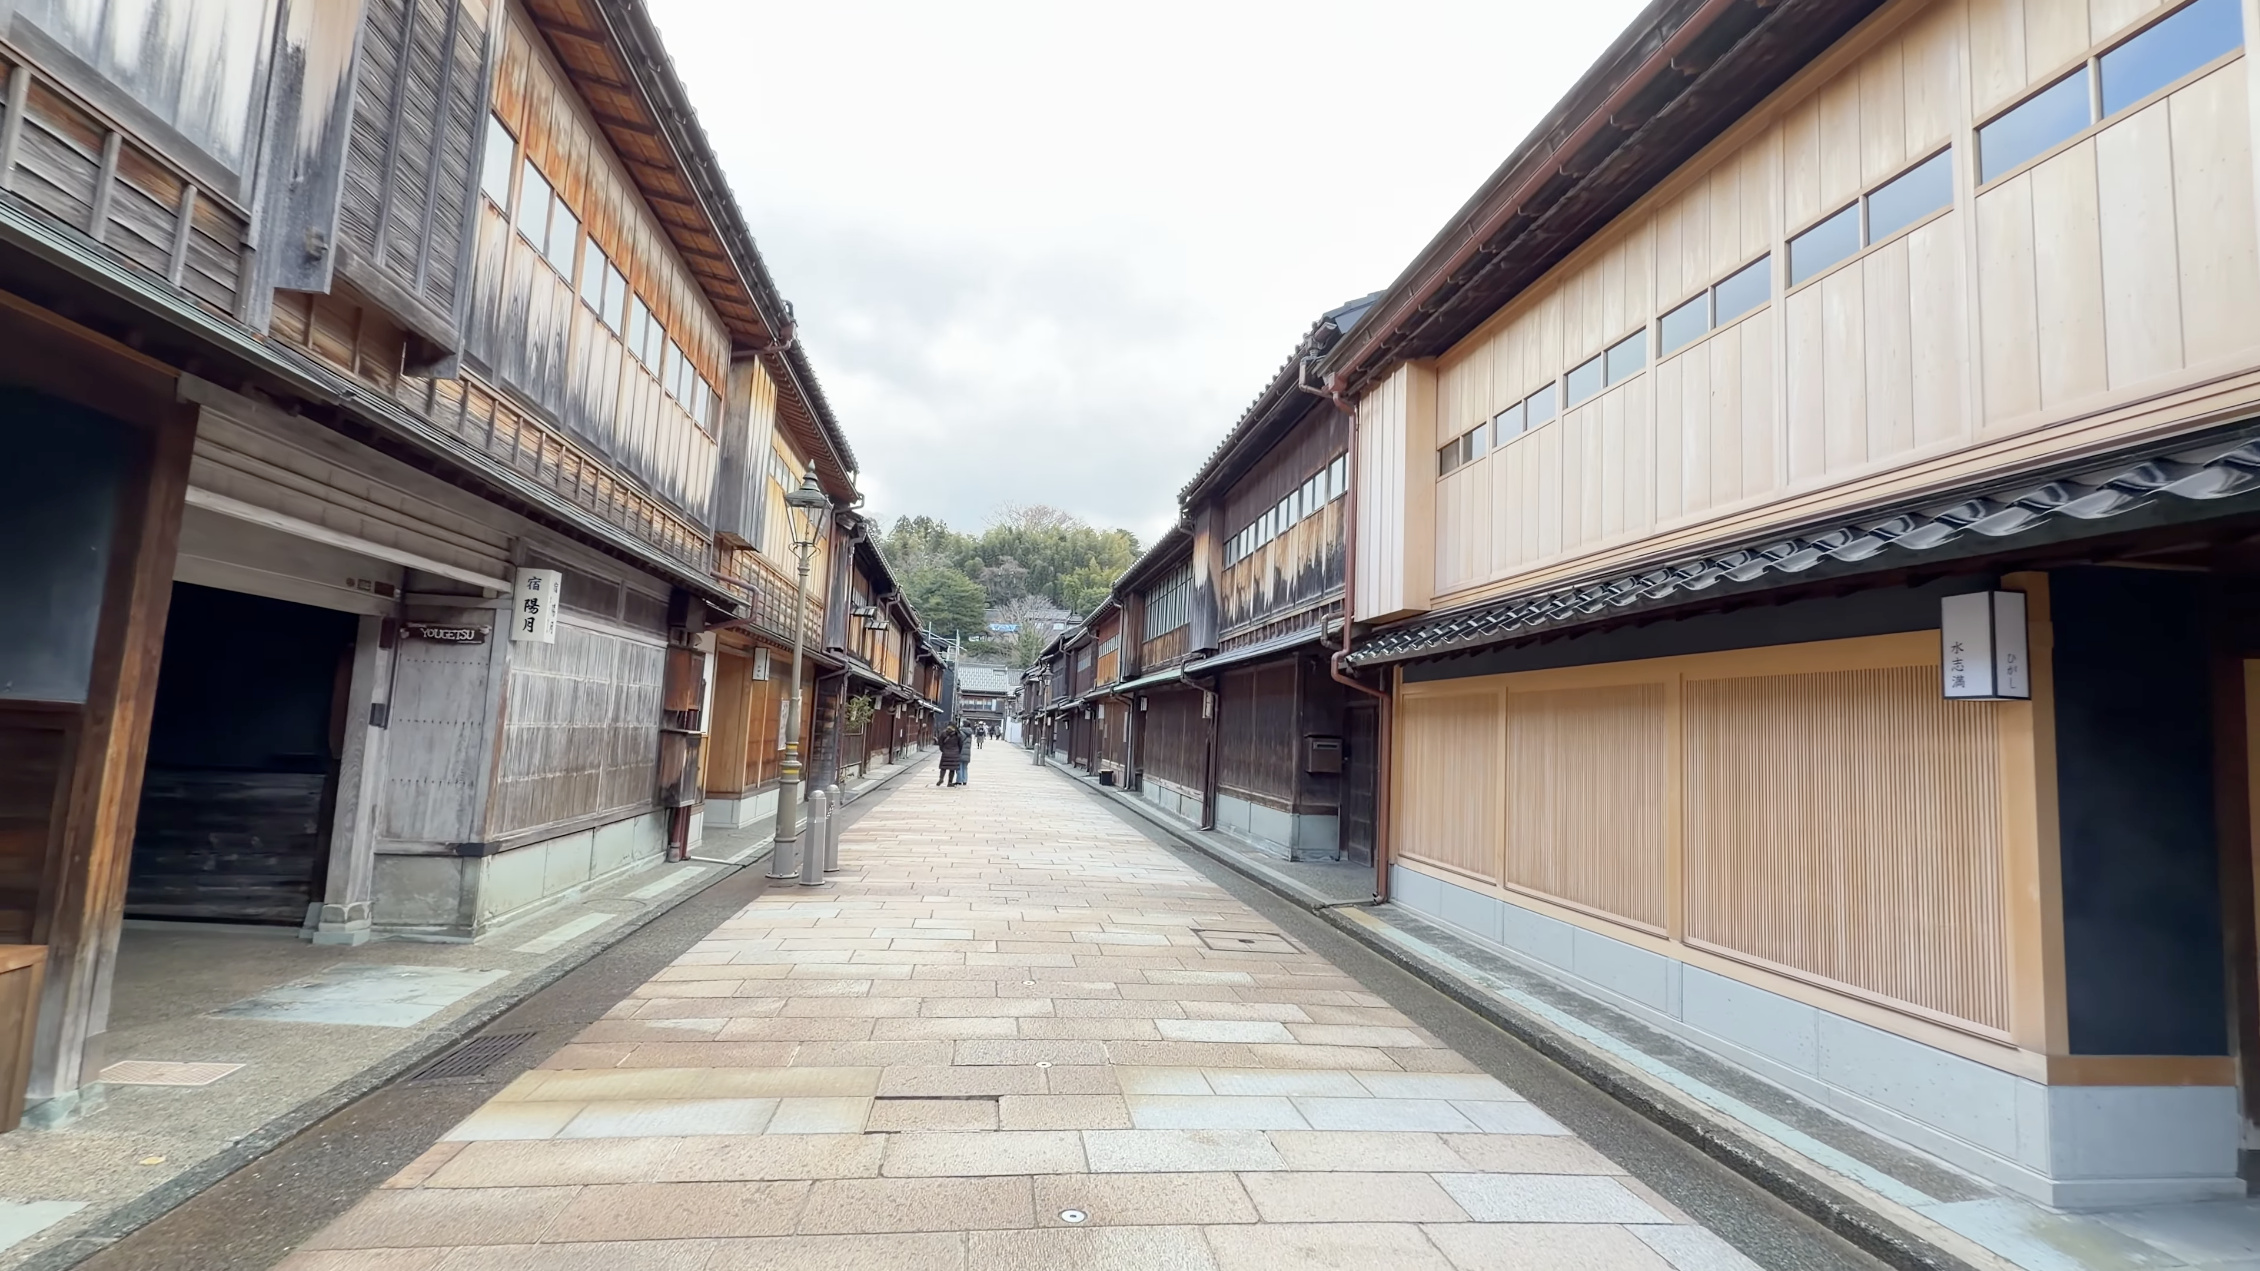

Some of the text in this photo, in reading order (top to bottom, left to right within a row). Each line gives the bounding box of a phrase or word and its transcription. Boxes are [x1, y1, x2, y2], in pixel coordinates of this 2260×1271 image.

[420, 628, 475, 640] YOUGETSU
[1951, 641, 1965, 688] 水志満
[2007, 653, 2018, 689] ひがし
